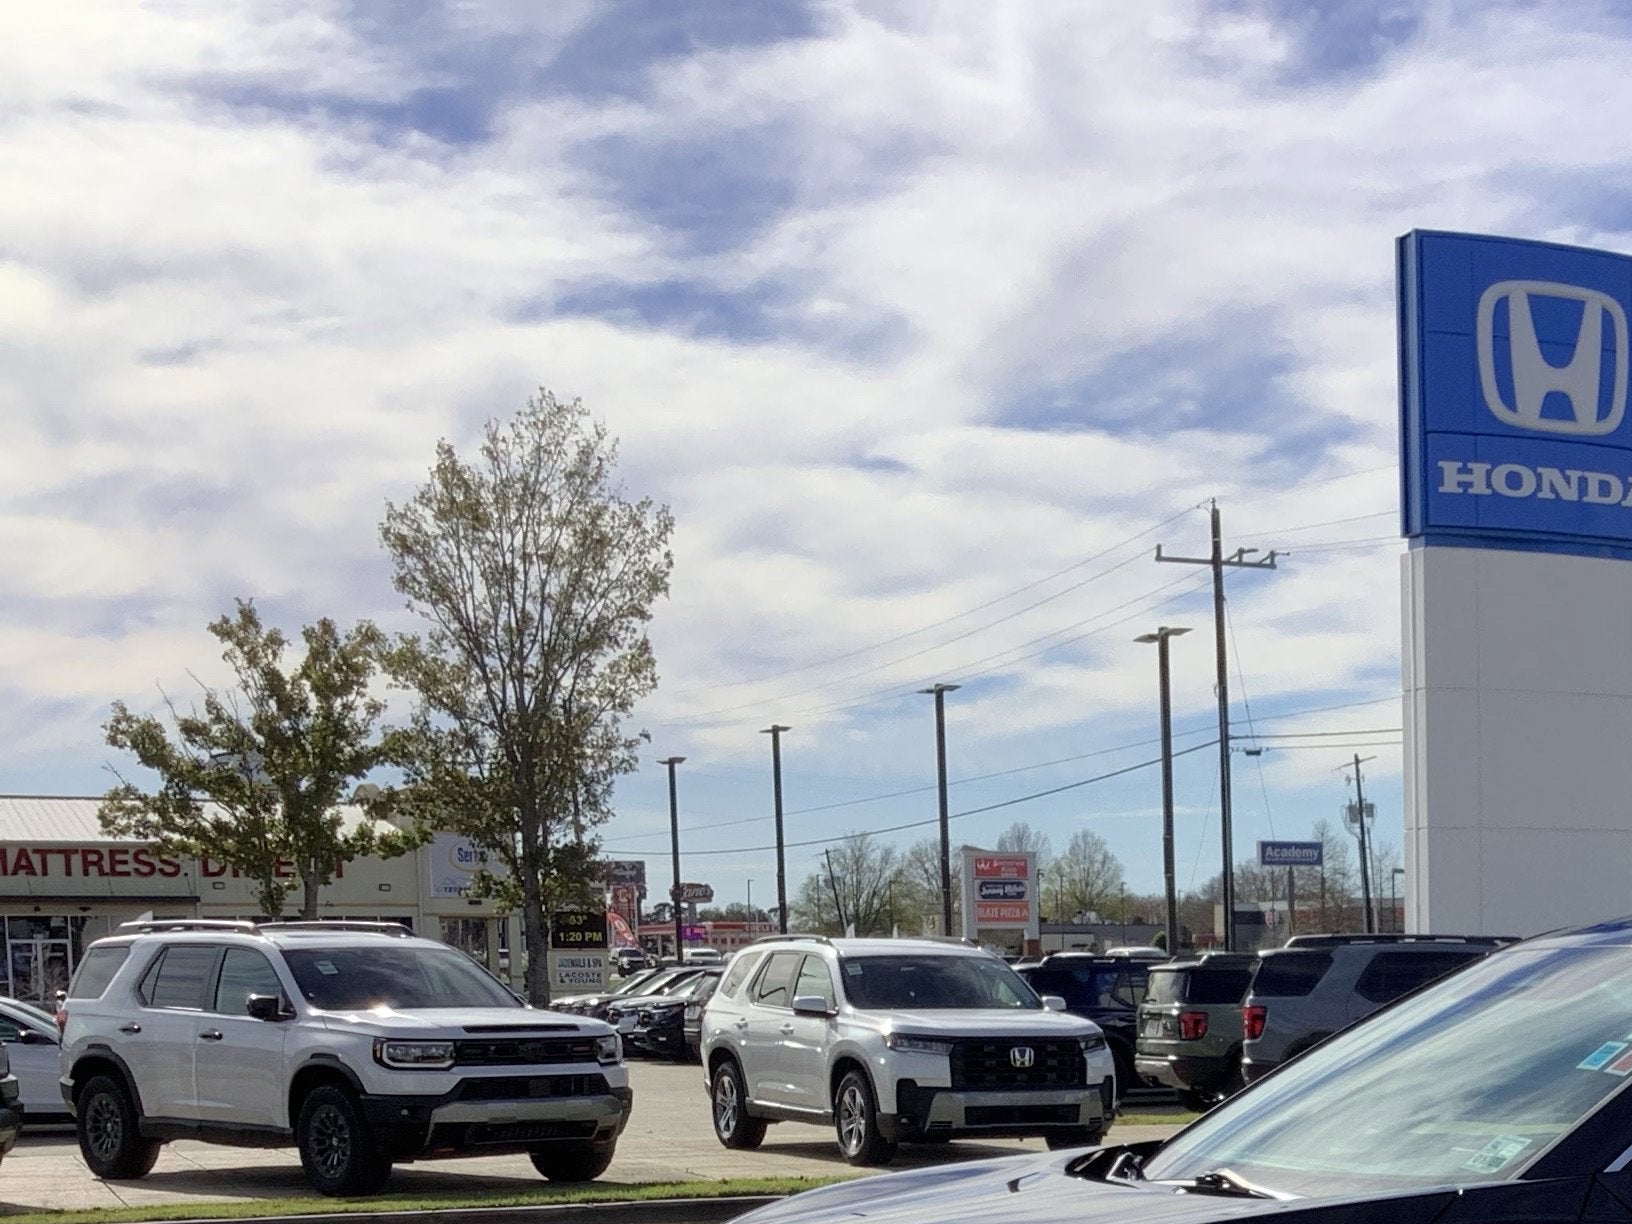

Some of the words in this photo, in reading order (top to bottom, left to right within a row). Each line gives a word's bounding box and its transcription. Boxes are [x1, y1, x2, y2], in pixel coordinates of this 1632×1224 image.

[1265, 845, 1320, 860] Academy
[559, 931, 582, 942] 1:20
[584, 931, 603, 942] PM
